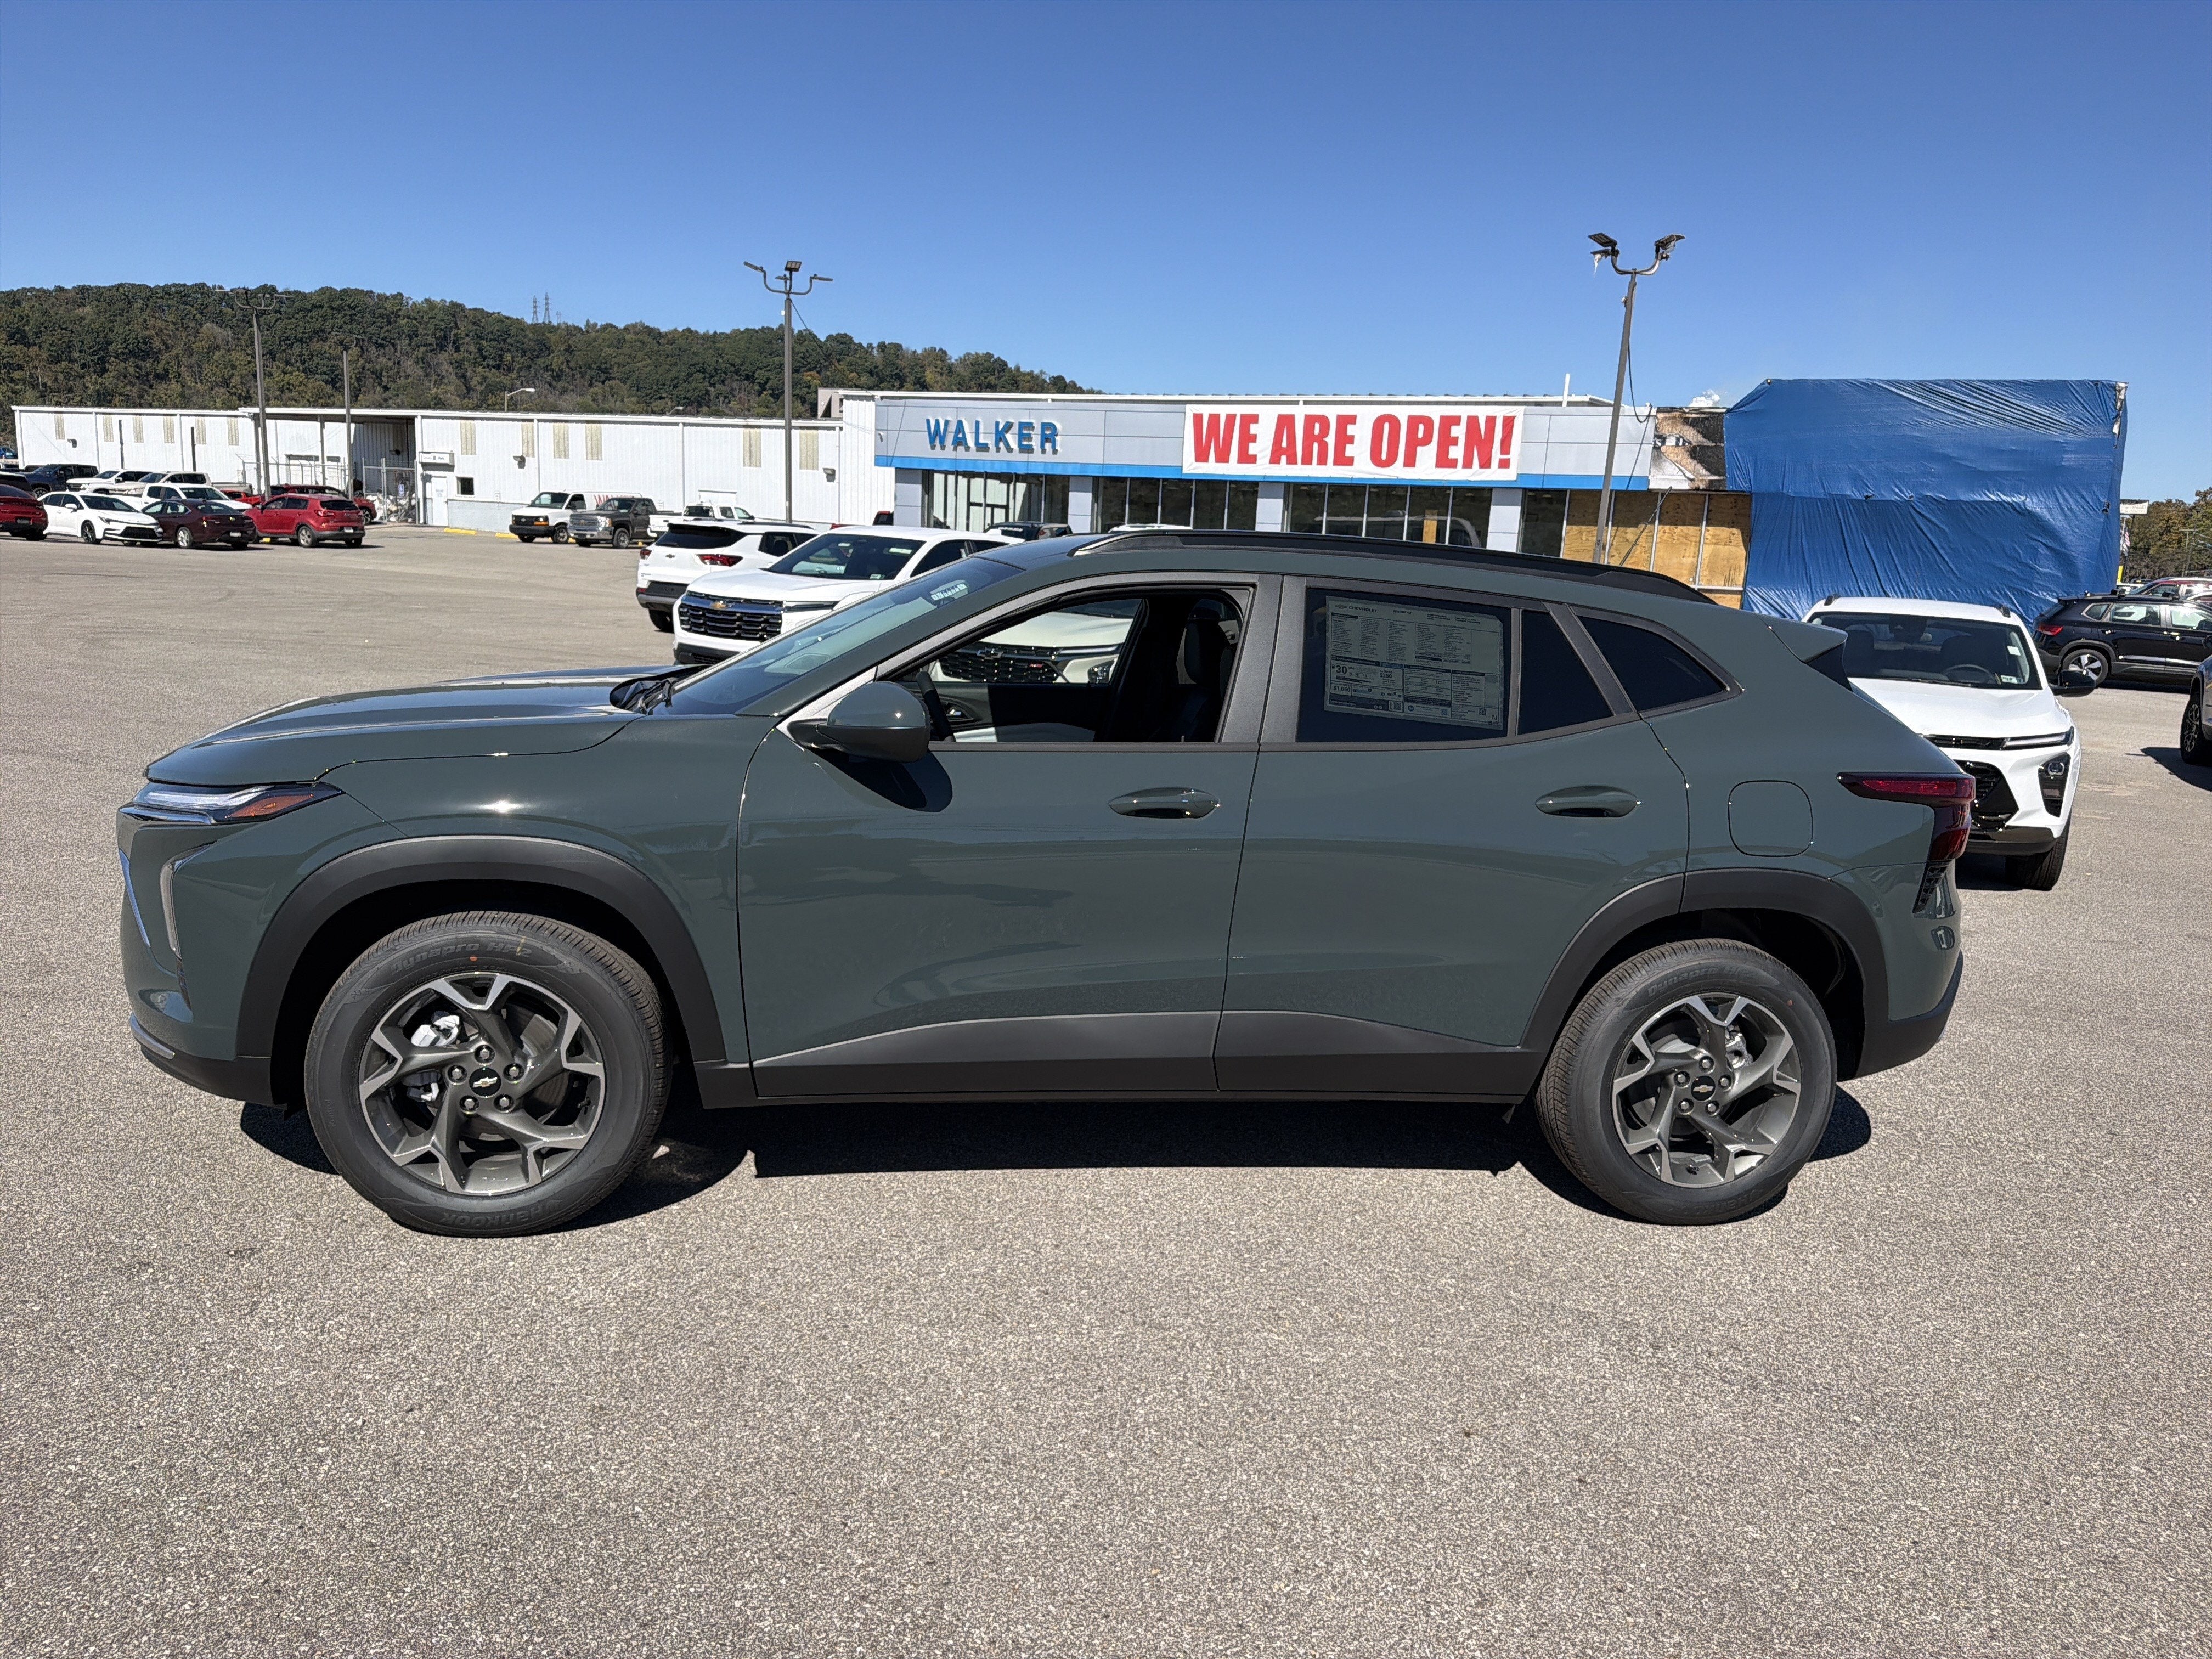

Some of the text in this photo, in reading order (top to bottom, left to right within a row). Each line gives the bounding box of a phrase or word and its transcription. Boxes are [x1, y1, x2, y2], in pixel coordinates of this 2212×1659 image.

[926, 418, 1059, 450] WALKER
[1193, 413, 1516, 469] WE ARE OPEN!
[1336, 665, 1347, 674] 30
